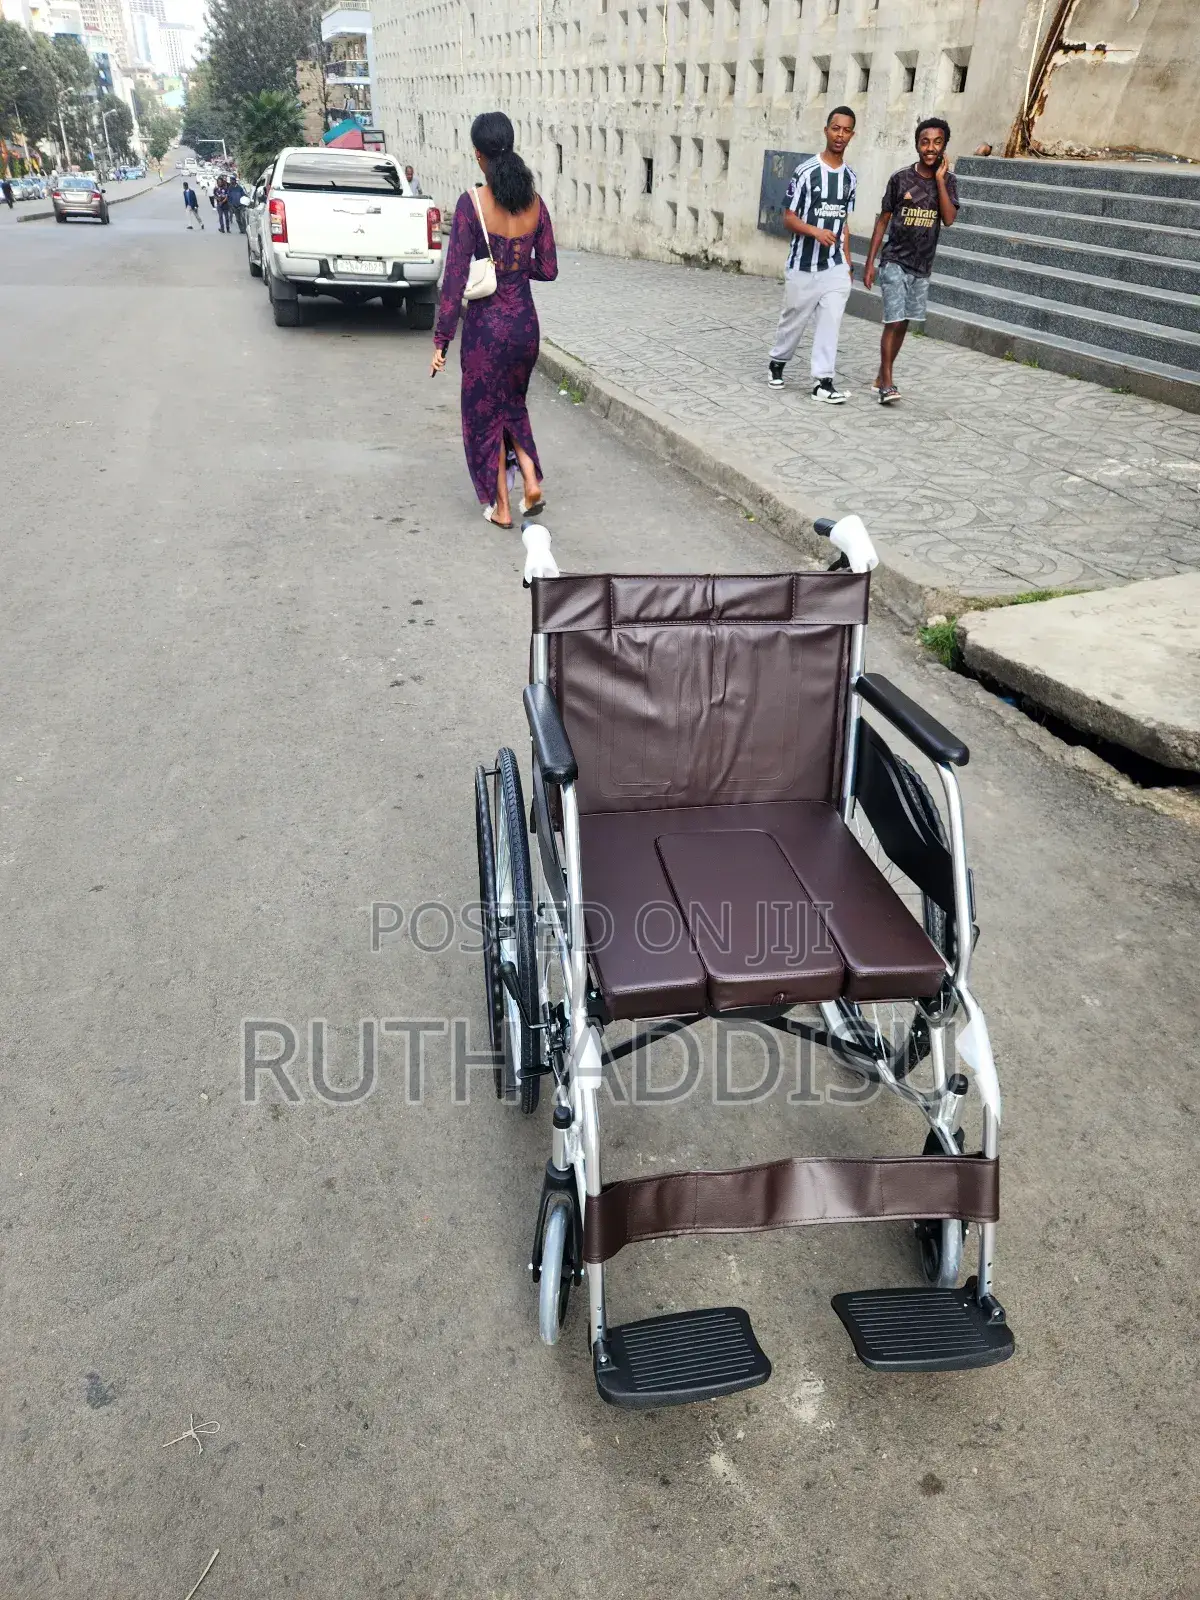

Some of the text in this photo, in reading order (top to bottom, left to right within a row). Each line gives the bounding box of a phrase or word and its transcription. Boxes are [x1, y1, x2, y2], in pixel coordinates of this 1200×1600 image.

[821, 202, 840, 210] Team
[814, 207, 839, 217] Viewer
[903, 217, 934, 228] FLY BETTER
